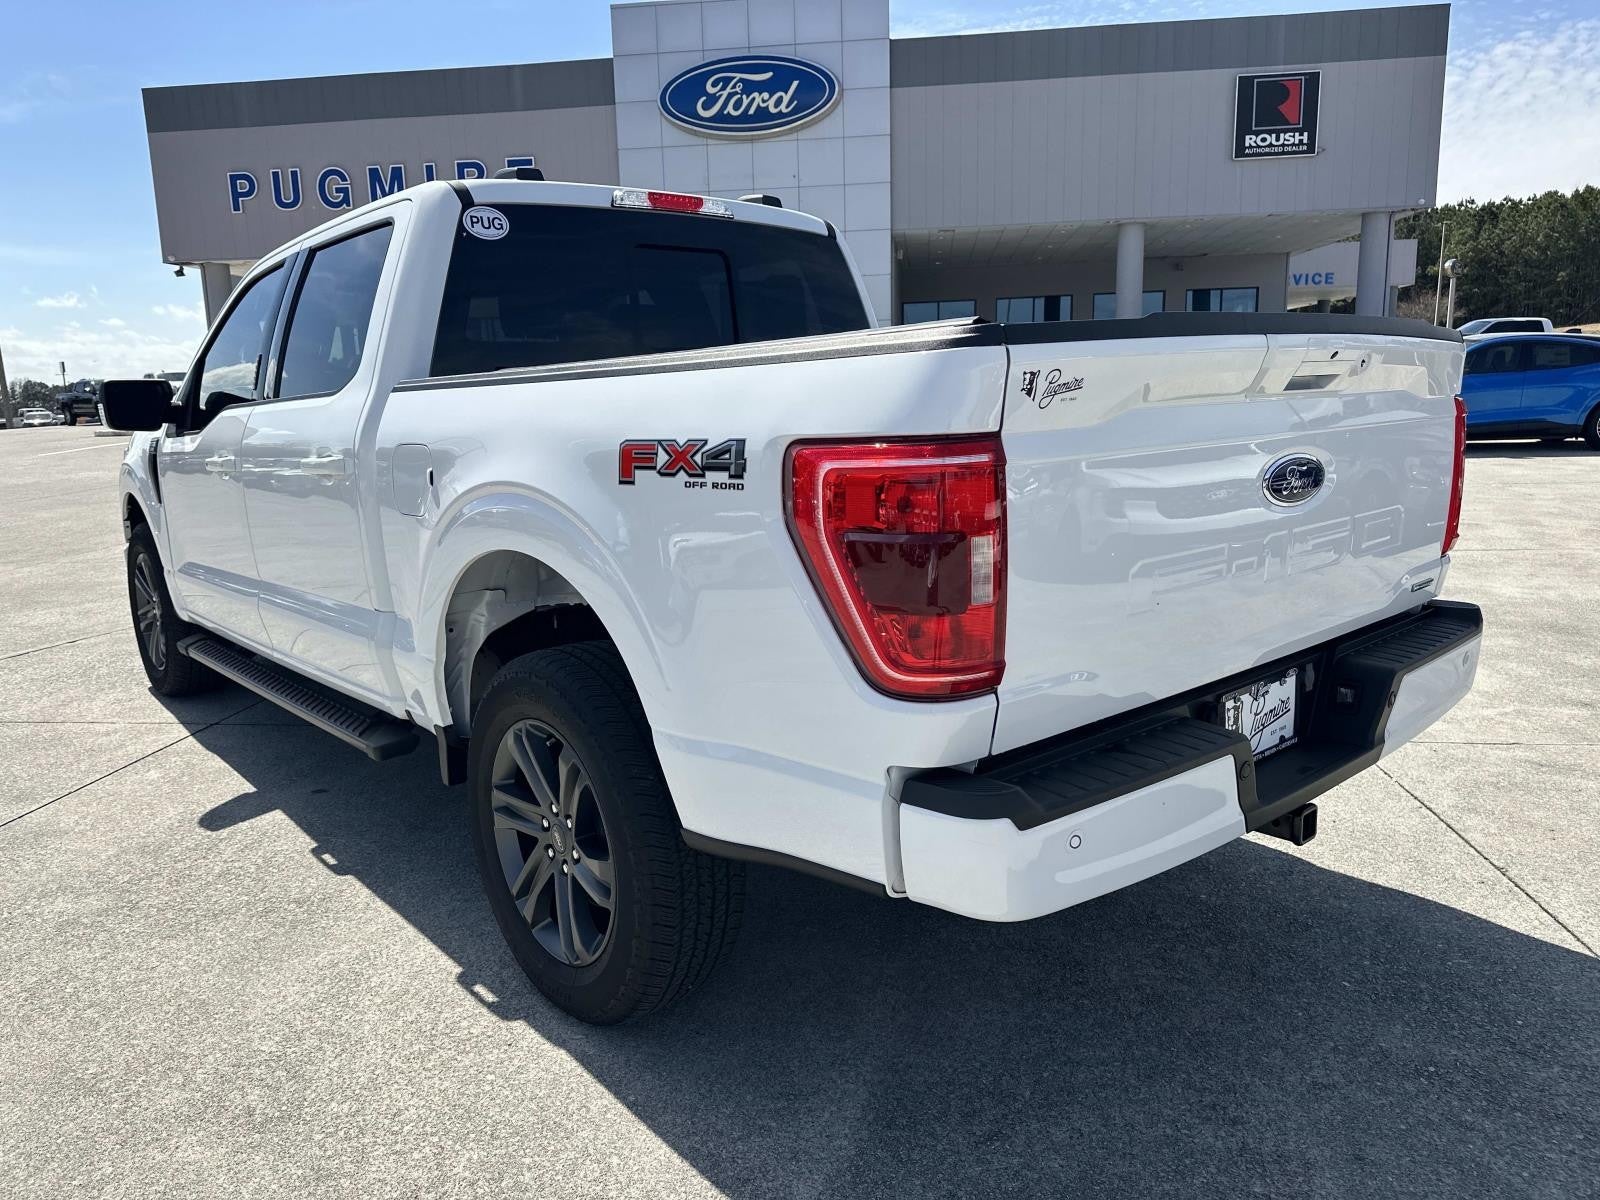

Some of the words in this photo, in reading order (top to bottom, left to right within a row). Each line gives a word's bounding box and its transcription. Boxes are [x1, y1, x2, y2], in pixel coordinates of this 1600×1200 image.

[696, 71, 800, 118] Ford
[1244, 132, 1308, 147] ROUSH
[1244, 146, 1283, 154] AUTHORIZED
[227, 156, 535, 213] PUGMI
[469, 215, 504, 231] PUG
[1039, 368, 1085, 409] Pugmire
[618, 438, 747, 485] FX4
[684, 481, 707, 489] OFF
[711, 482, 745, 491] ROAD
[1281, 465, 1317, 496] Ford
